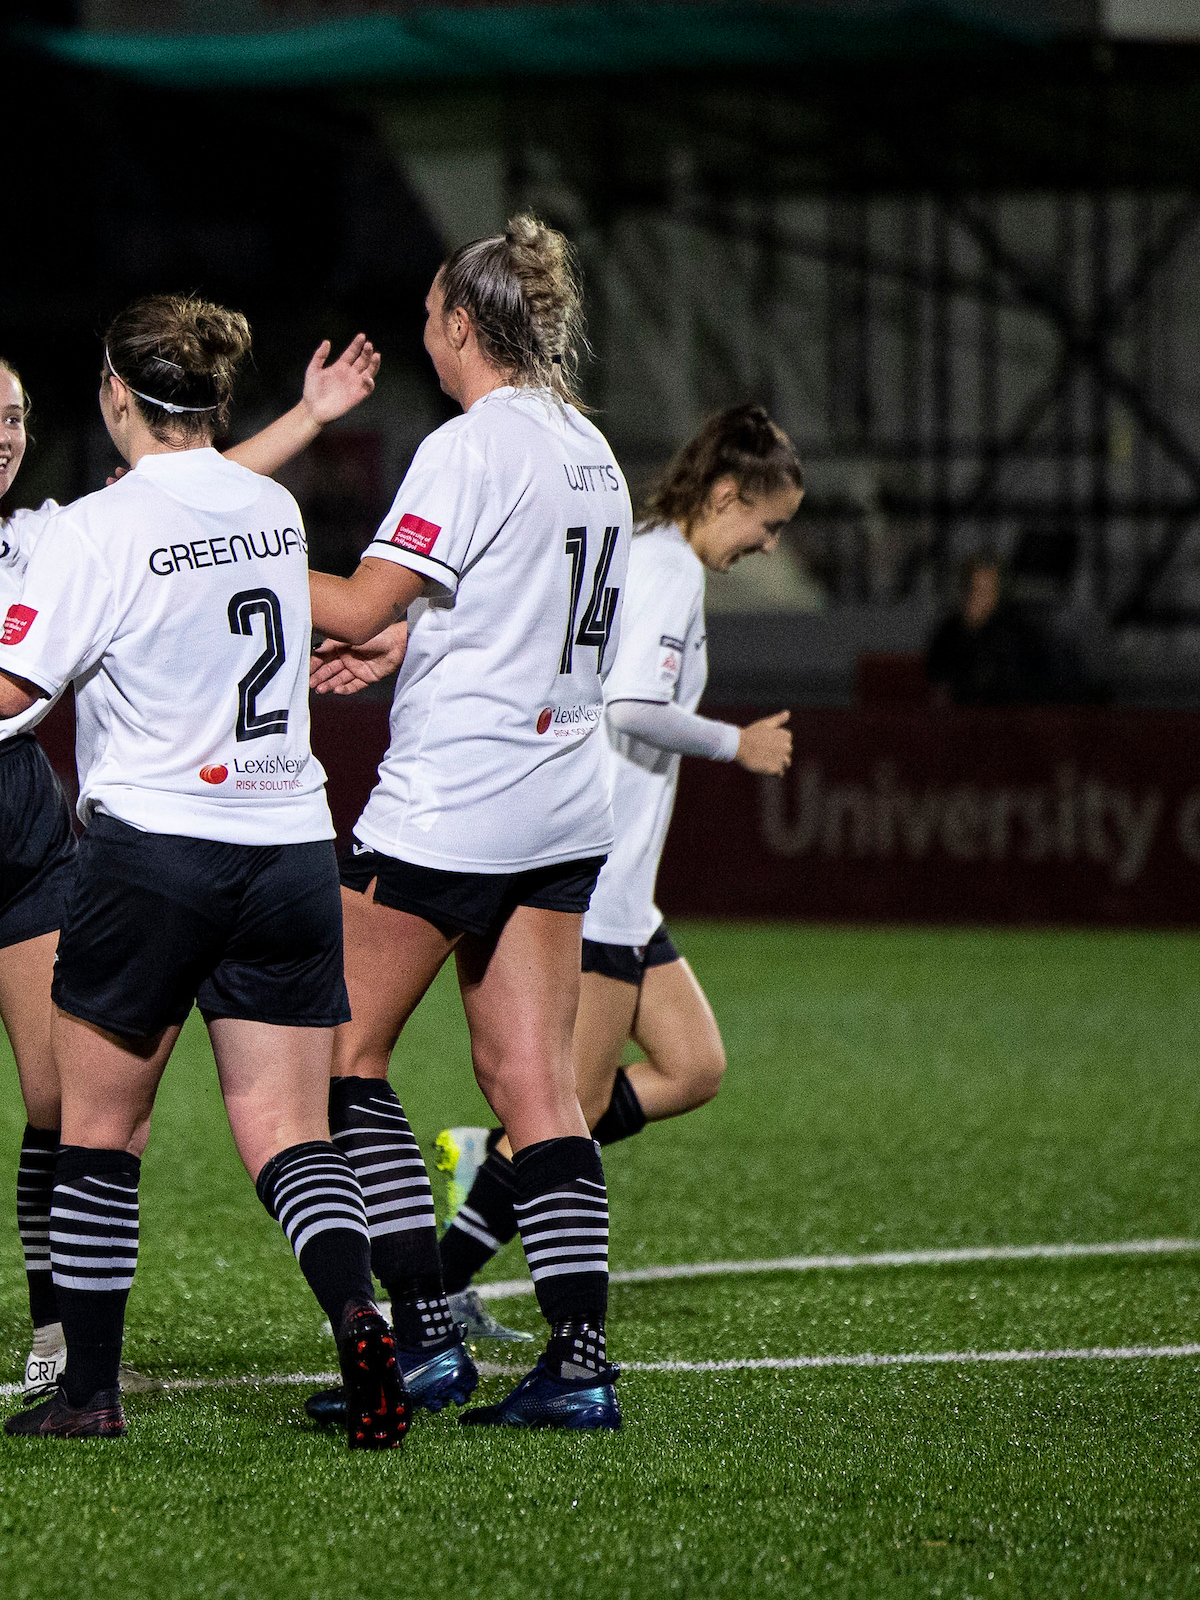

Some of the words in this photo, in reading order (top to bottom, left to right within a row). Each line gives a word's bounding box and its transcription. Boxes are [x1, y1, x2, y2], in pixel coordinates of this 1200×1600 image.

[563, 464, 619, 493] WITTS
[396, 532, 412, 542] South
[412, 537, 427, 548] Wales
[399, 526, 424, 541] University
[559, 526, 620, 675] 14
[227, 587, 289, 742] 2
[236, 780, 257, 790] RISK
[759, 756, 1166, 885] University
[27, 1361, 57, 1381] CR7
